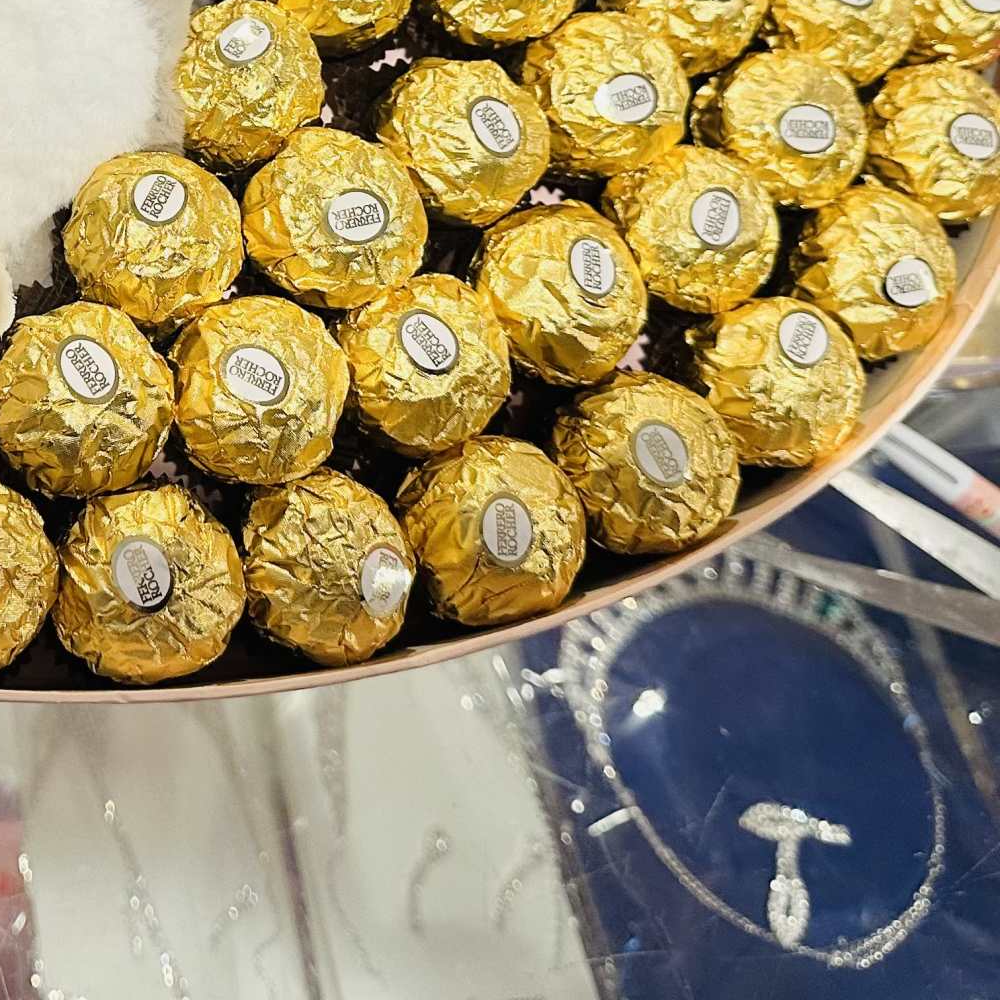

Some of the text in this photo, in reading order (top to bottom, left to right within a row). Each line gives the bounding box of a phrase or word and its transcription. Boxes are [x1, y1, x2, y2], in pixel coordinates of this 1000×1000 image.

[475, 109, 507, 150] FERRERO
[484, 103, 514, 144] ROCHER
[140, 176, 166, 213] FERRERO
[150, 180, 176, 218] ROCHER
[332, 203, 378, 220] ROCHER
[702, 195, 722, 236] ROCHER
[335, 214, 381, 230] FERRERO
[712, 198, 730, 242] FERRERO
[582, 242, 592, 288] FERRERO
[591, 246, 602, 290] ROCHER
[406, 324, 444, 367] FERRERO
[414, 317, 451, 360] ROCHER
[795, 321, 816, 359] ROCHER
[66, 349, 101, 395] FERRERO
[75, 343, 110, 390] ROCHER
[229, 366, 278, 395] FERRERO
[235, 356, 282, 386] ROCHER
[641, 433, 673, 480] FERRERO
[650, 429, 682, 476] ROCHER
[496, 503, 507, 556] FERRERO
[506, 504, 517, 556] ROCHER
[123, 550, 152, 604] FERRERO
[134, 545, 163, 600] ROCHER
